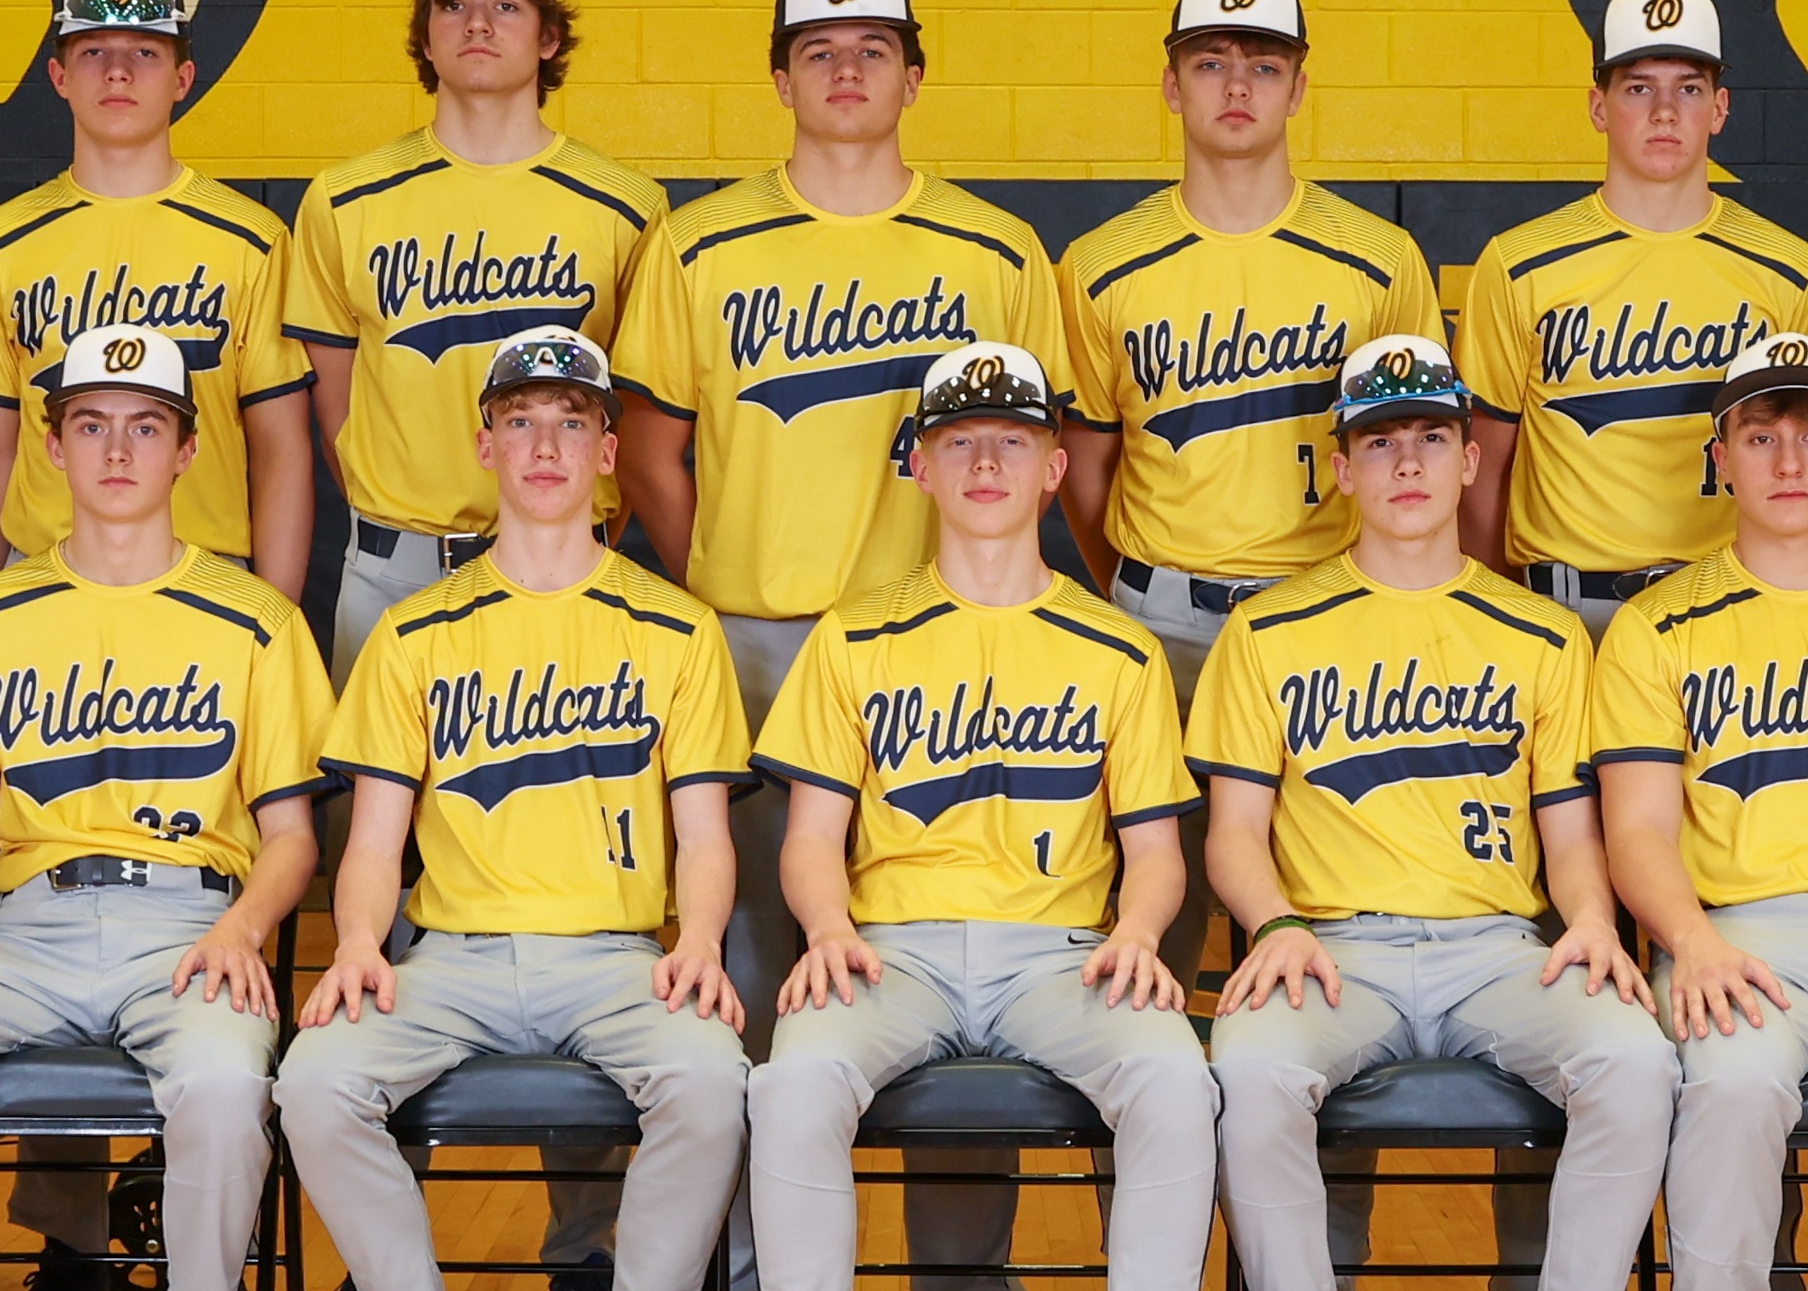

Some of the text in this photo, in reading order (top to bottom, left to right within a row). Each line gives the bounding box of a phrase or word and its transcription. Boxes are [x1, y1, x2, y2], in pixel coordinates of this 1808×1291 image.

[10, 264, 228, 359] Wildcats
[369, 230, 583, 320] Wildcats
[723, 276, 976, 371] Wildcats
[1124, 303, 1348, 403] Wildcats
[1296, 443, 1320, 504] 7
[428, 661, 648, 762] Wildcats
[863, 676, 1104, 774] Wildcats
[1280, 657, 1523, 756] Wildcats
[1032, 829, 1062, 878] 1
[1459, 800, 1514, 863] 25
